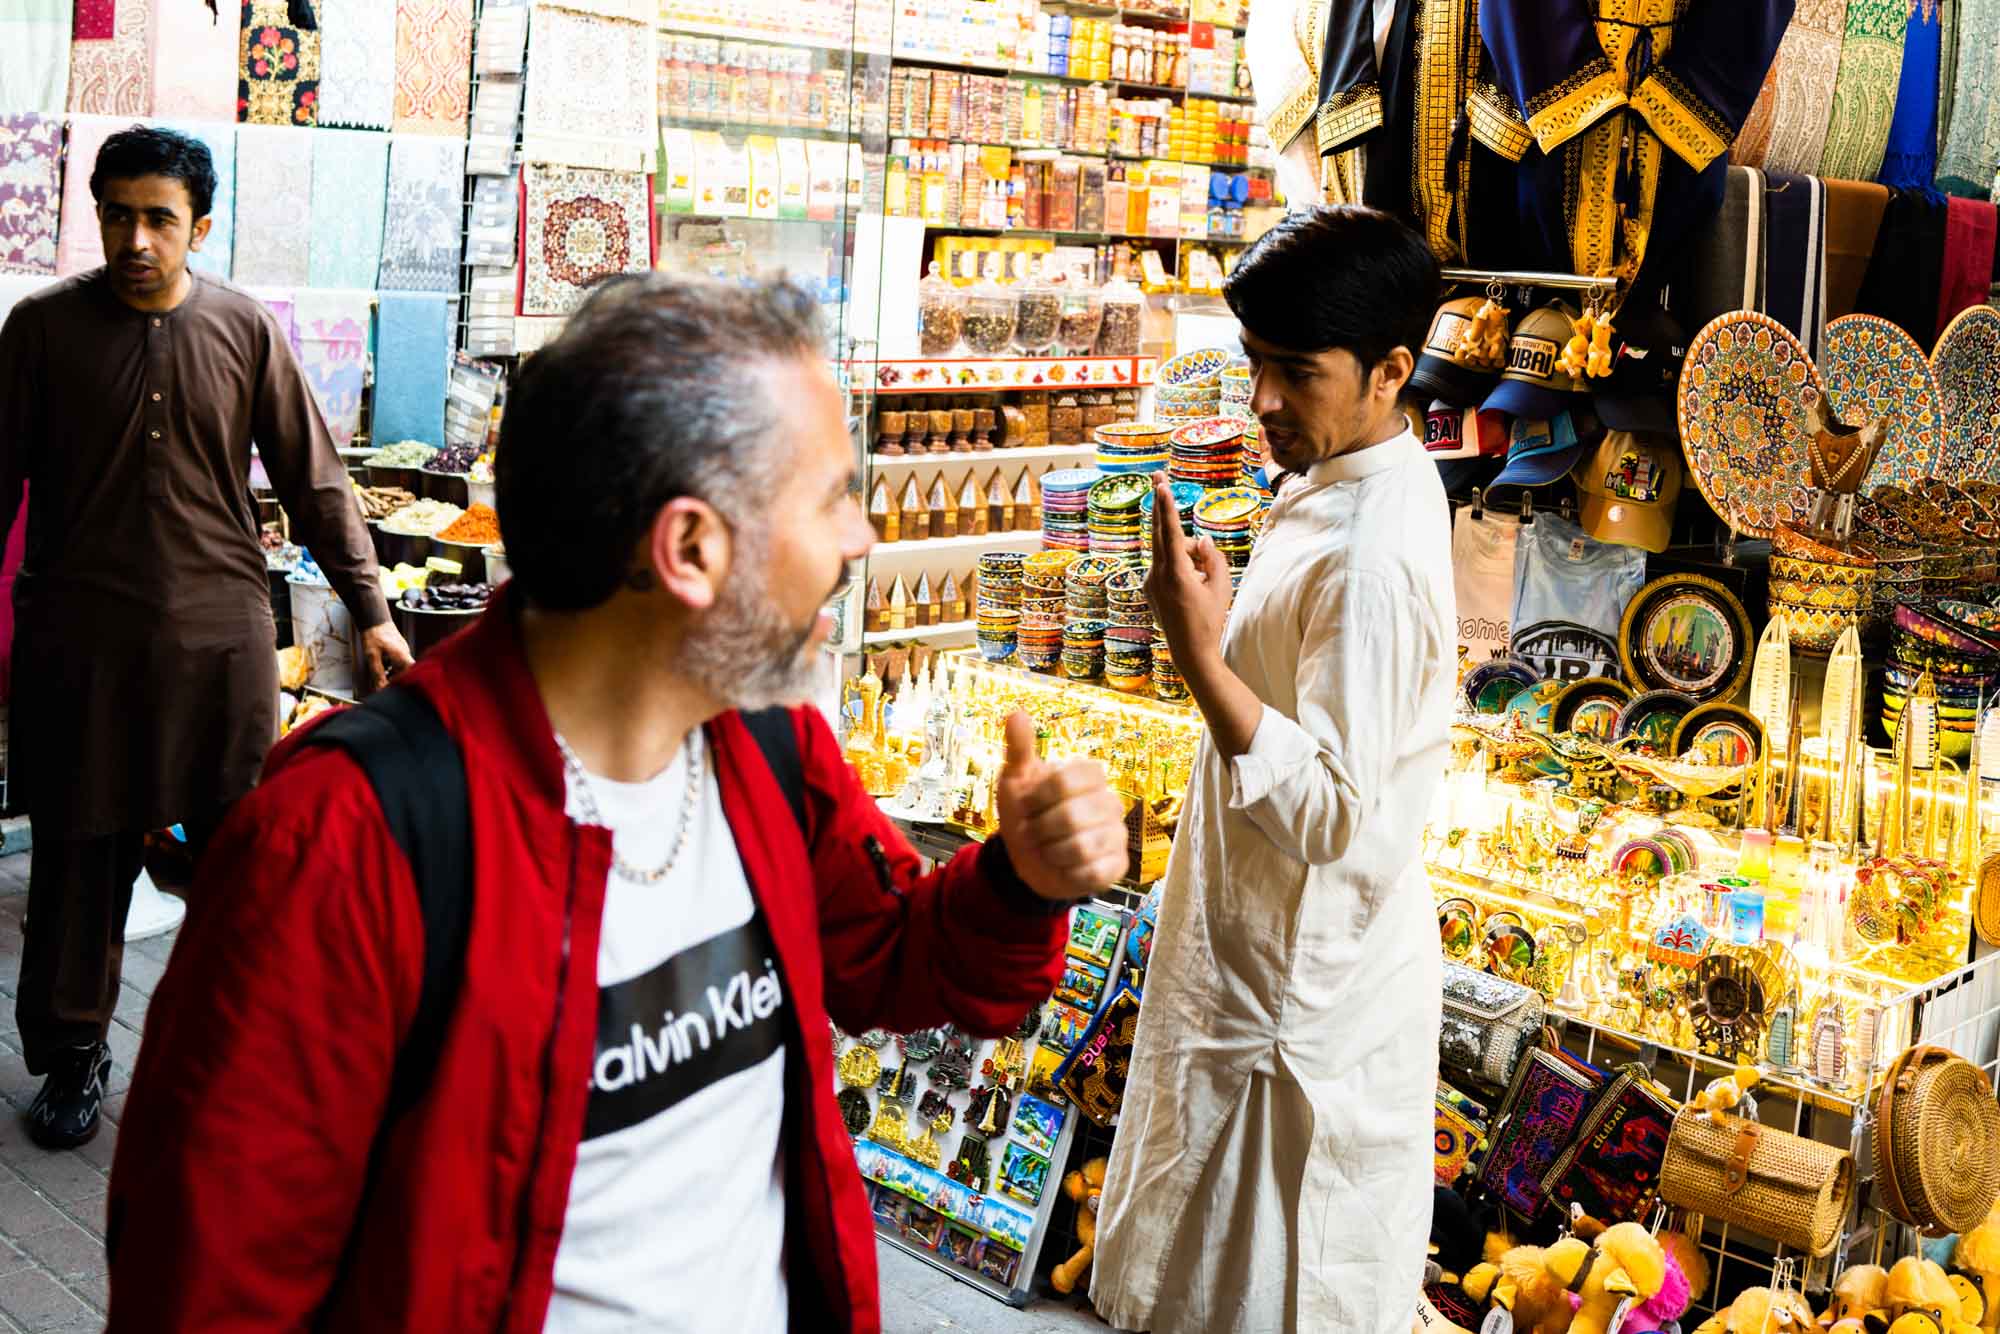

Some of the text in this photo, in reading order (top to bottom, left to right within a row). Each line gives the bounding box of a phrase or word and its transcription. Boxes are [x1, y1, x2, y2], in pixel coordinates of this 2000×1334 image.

[1507, 347, 1553, 374] UBAI
[1424, 415, 1460, 444] BAI
[588, 1010, 711, 1091] alvin
[1082, 1020, 1116, 1067] DUBAI
[1593, 1104, 1628, 1150] dubai
